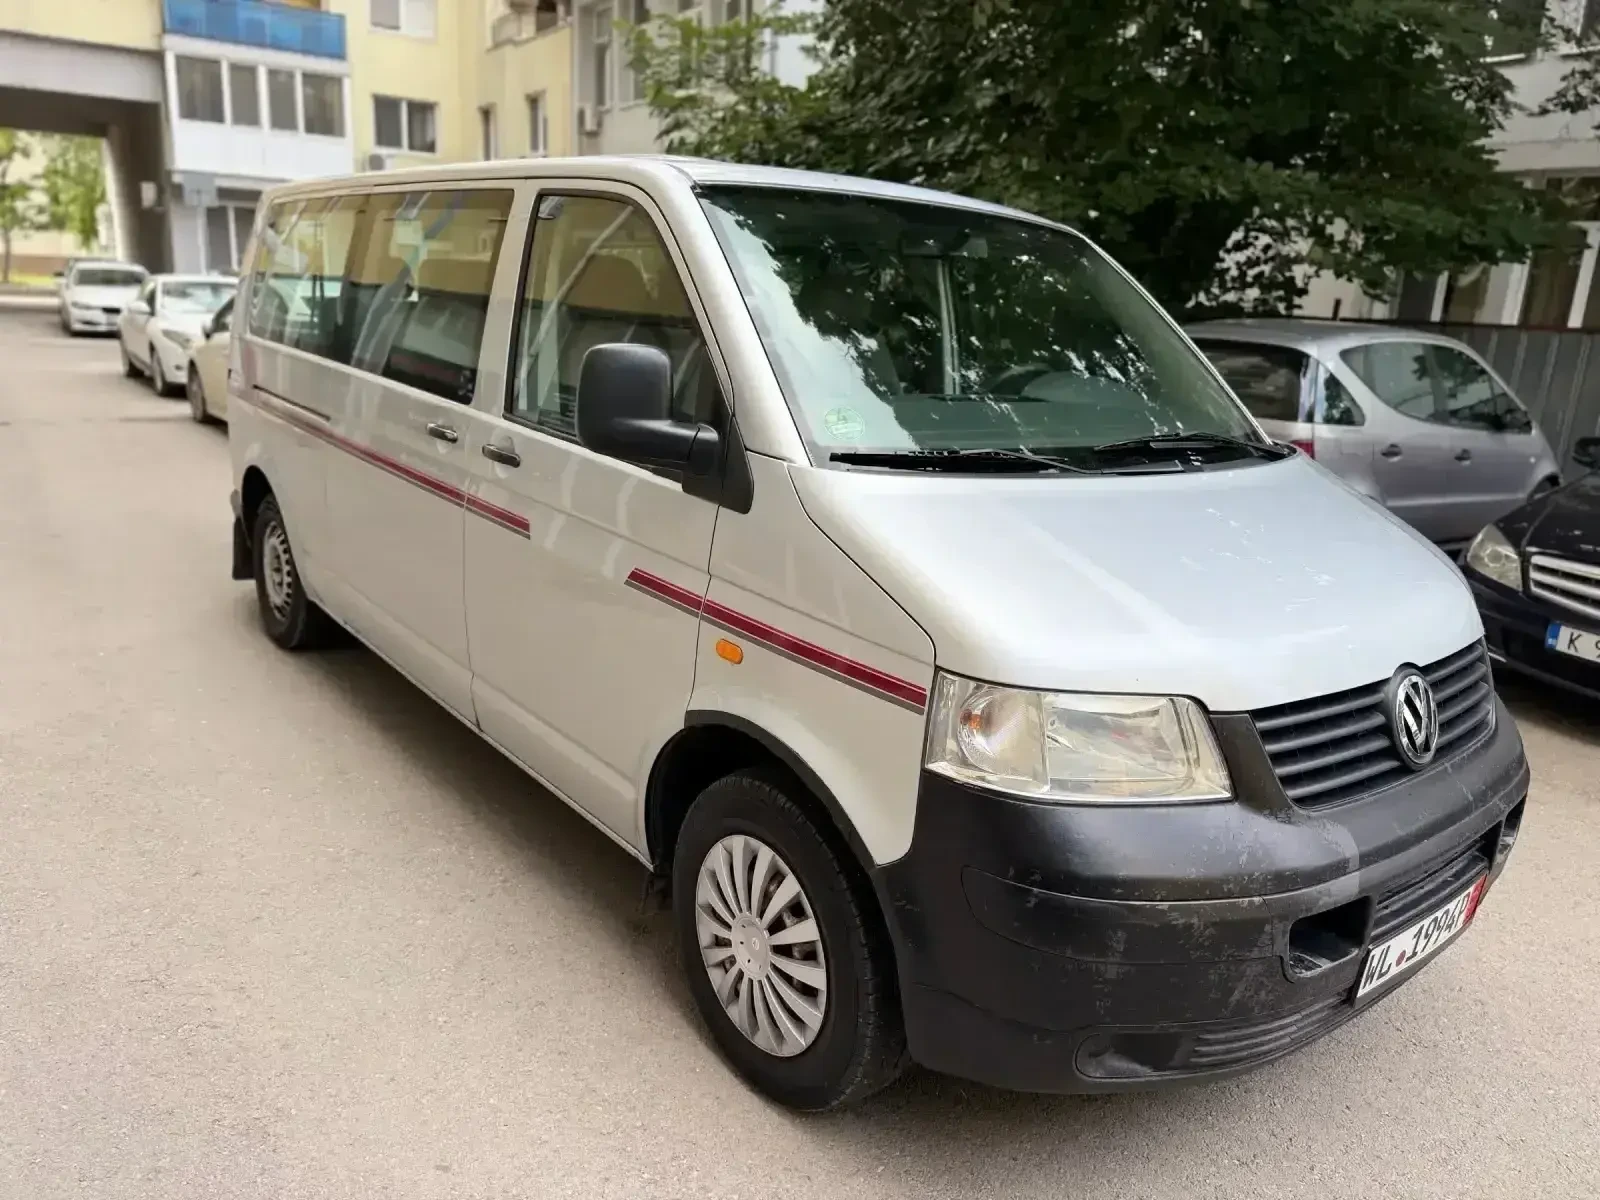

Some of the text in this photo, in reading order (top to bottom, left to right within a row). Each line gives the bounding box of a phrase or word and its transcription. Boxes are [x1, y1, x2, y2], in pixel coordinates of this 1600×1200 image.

[1567, 631, 1582, 653] K
[1362, 944, 1393, 990] WL
[1405, 891, 1471, 963] 1994P
